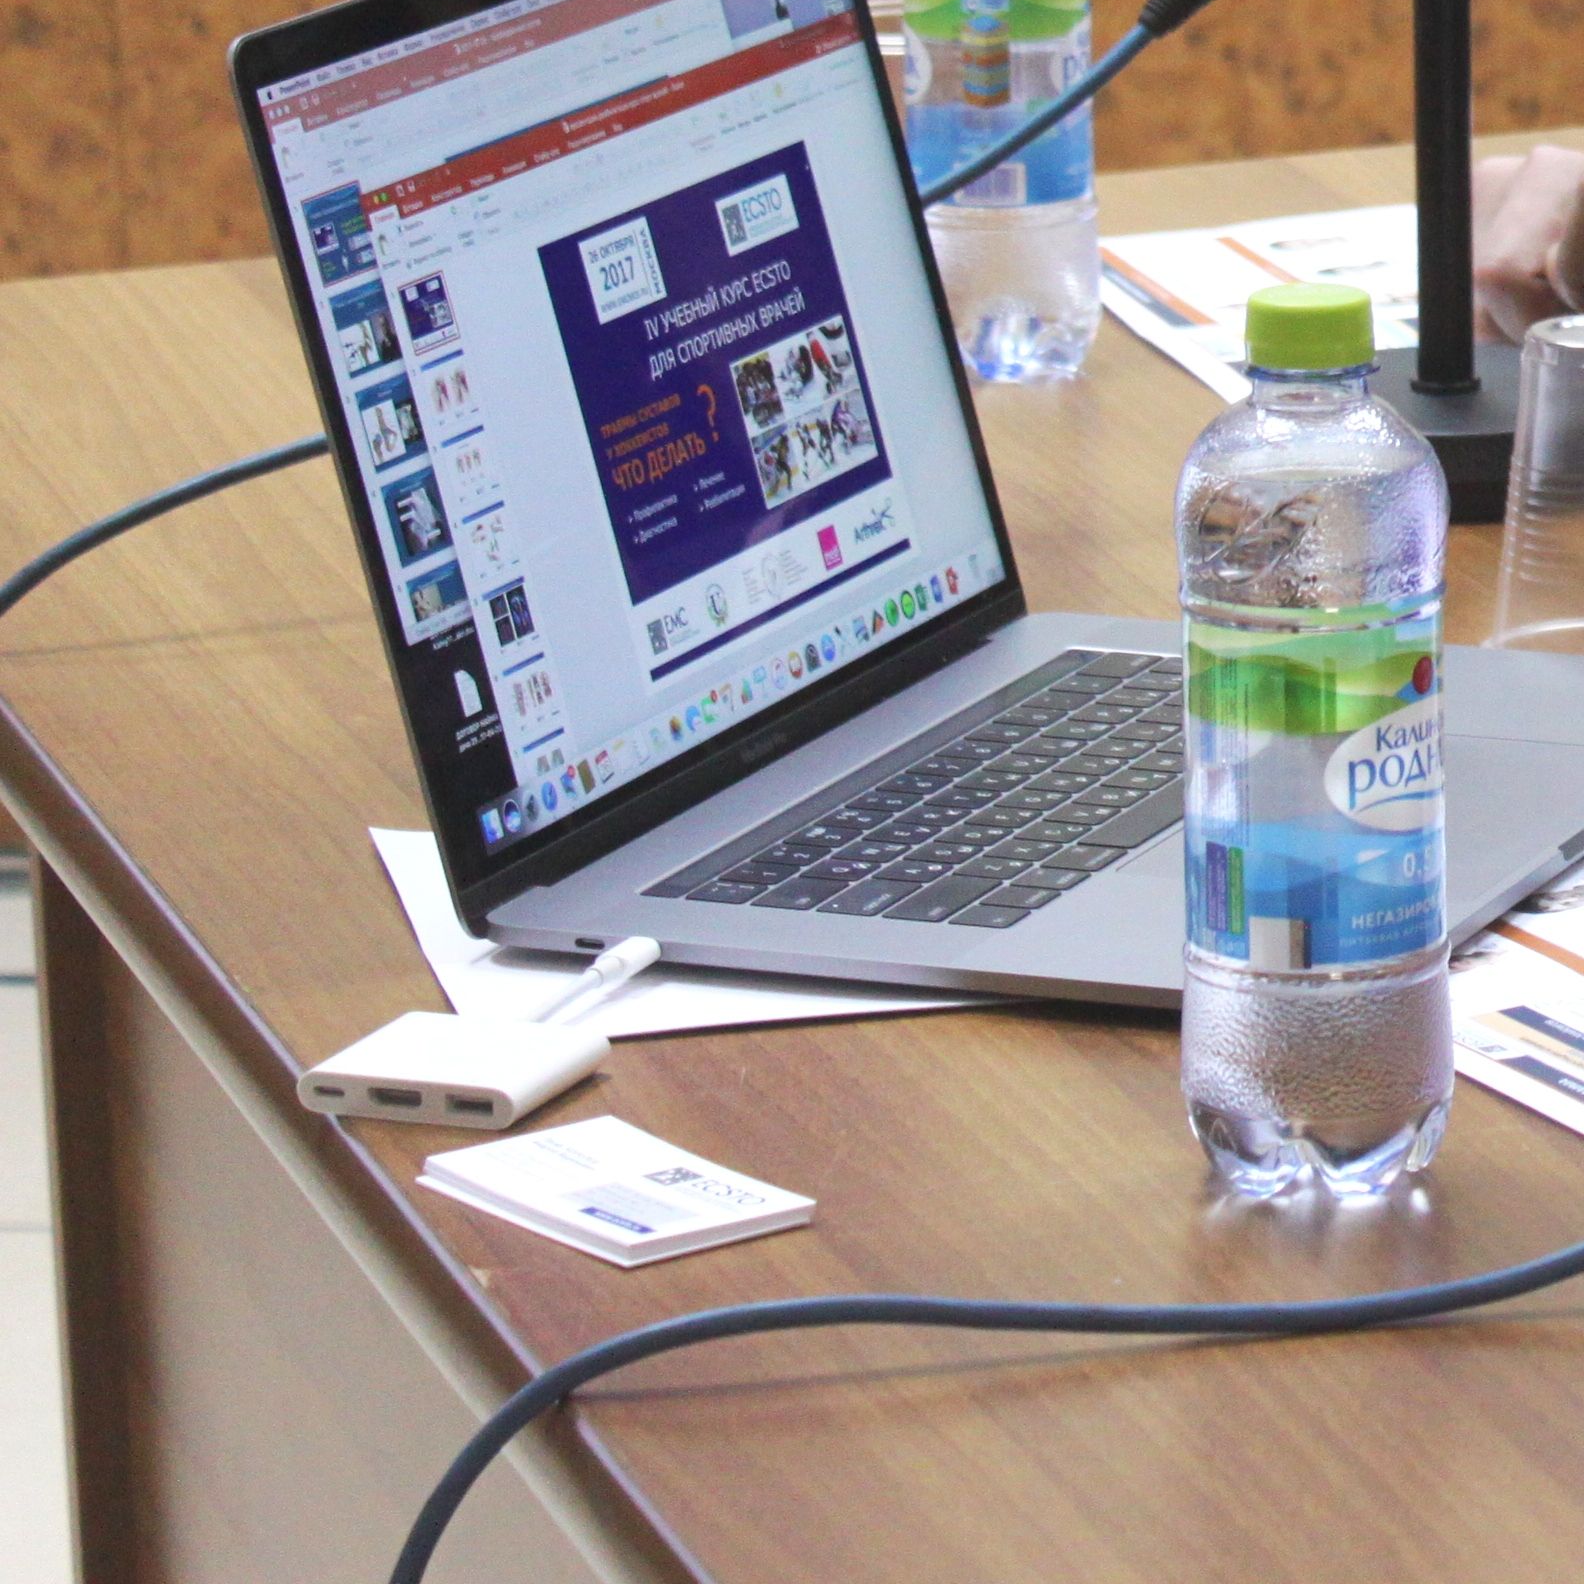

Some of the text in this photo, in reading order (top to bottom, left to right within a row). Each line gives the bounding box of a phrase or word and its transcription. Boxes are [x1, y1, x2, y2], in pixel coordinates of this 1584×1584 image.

[742, 187, 783, 223] ECSTO
[588, 234, 636, 264] 26 ОКТЯБРЯ
[640, 227, 663, 295] МОСКВА
[599, 256, 636, 291] 2017
[644, 260, 792, 341] IV УЧЕБНЫЙ КУРС ECSTO
[649, 286, 806, 382] ДЛЯ СПОРТИВНЫХ ВРАЧЕЙ
[612, 457, 646, 491] ЧТО
[646, 432, 707, 484] ДЕЛАТЬ
[663, 606, 689, 634] EMC
[692, 1179, 766, 1206] ECSTO
